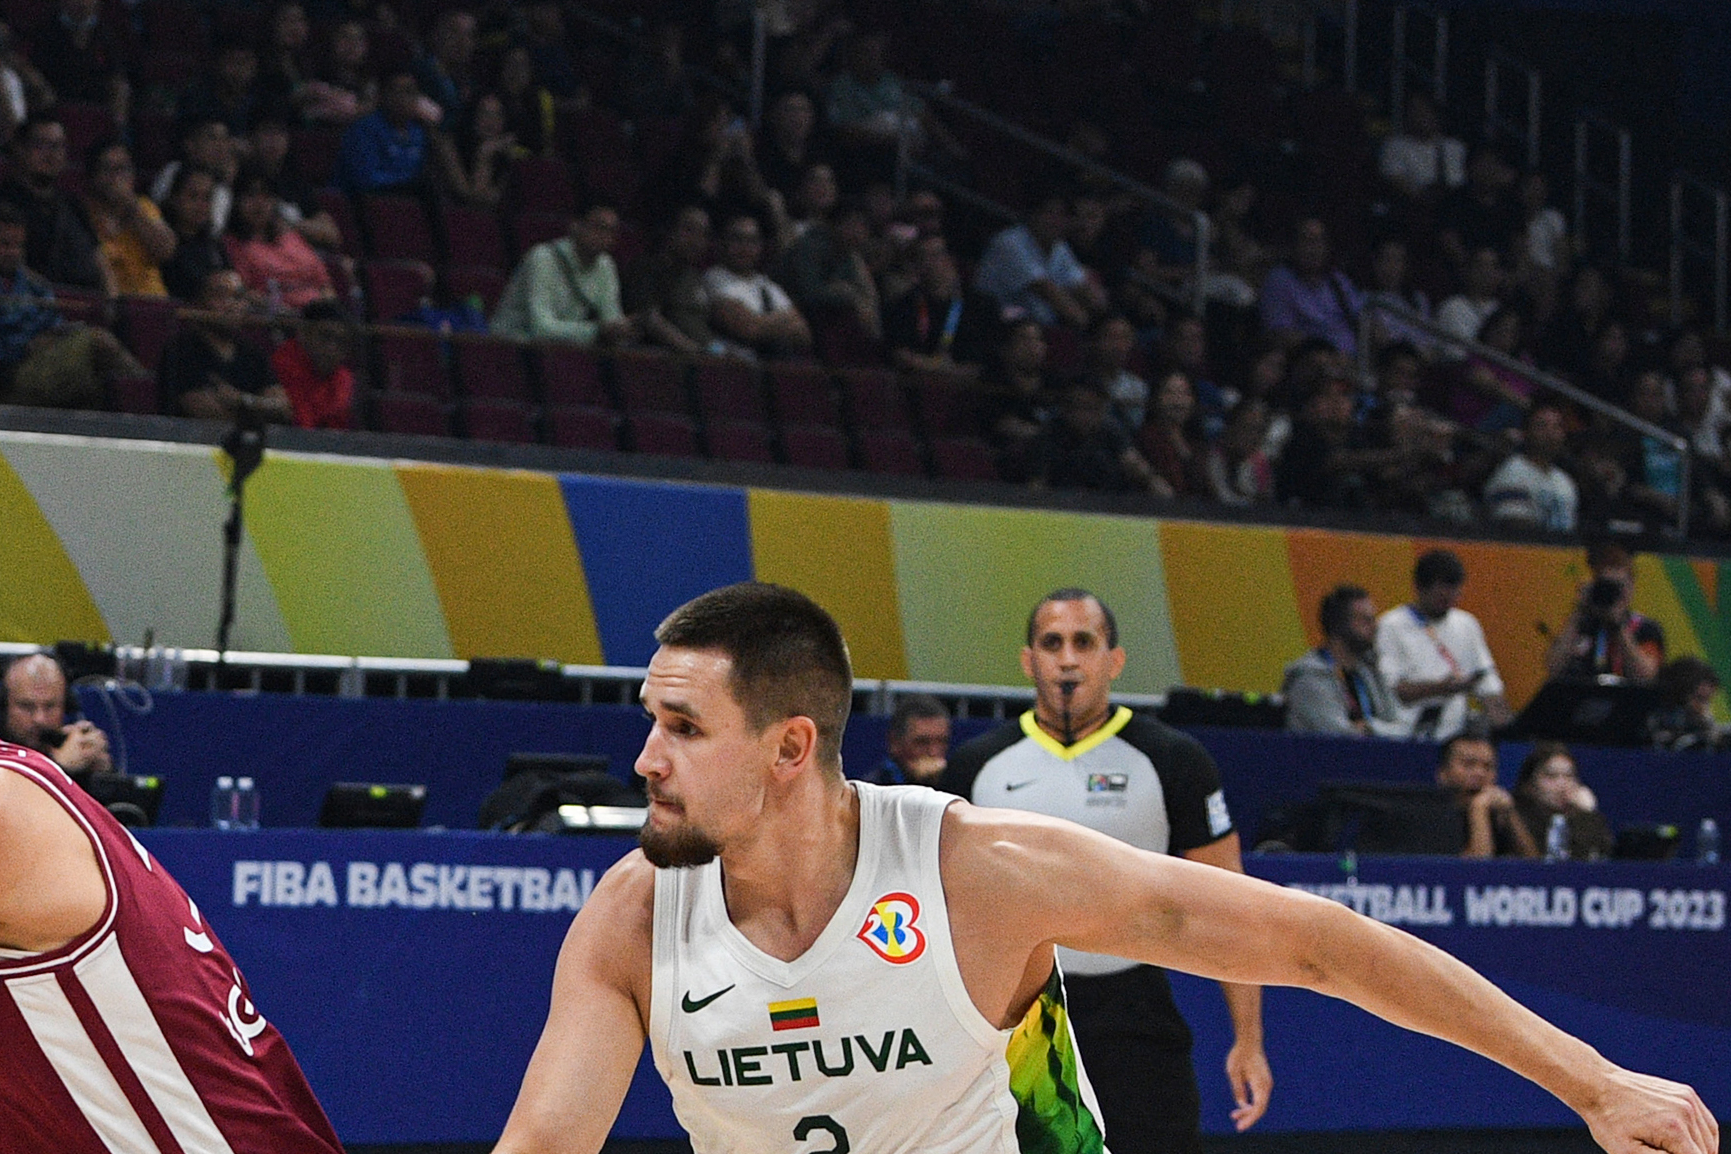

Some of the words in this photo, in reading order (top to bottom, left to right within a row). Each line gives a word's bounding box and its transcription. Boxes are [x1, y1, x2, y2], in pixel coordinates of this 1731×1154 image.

[232, 860, 338, 907] FIBA
[346, 862, 594, 912] BASKETBAL
[1464, 887, 1576, 926] WORLD
[1581, 888, 1644, 927] CUP
[1649, 890, 1725, 930] 2023
[684, 1028, 933, 1087] LIETUVA
